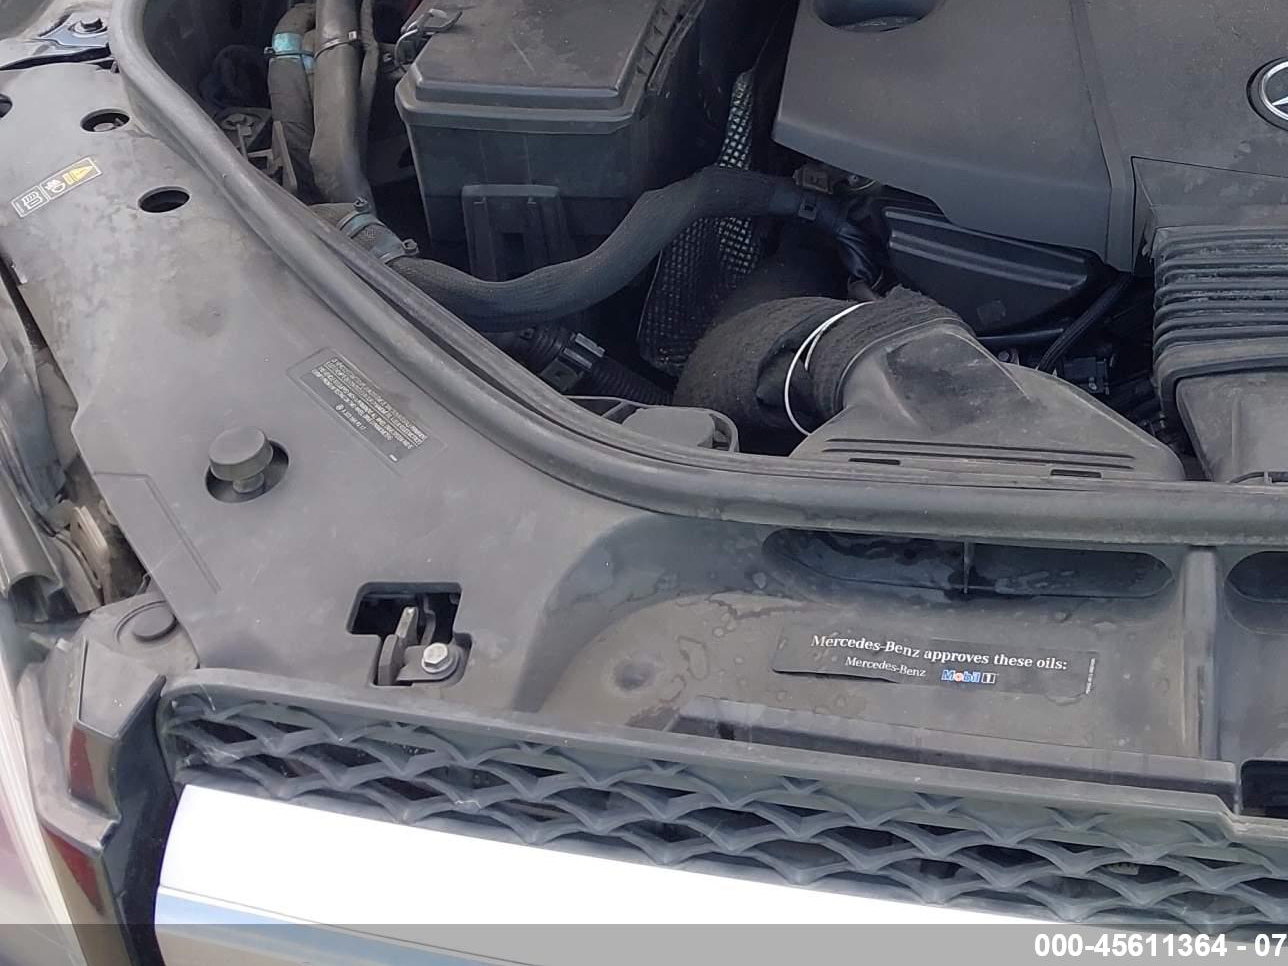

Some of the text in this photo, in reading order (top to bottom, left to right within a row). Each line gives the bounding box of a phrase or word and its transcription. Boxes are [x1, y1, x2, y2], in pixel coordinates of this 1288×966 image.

[811, 634, 1068, 670] Mercedes-Benz approves these oils:
[844, 656, 926, 677] Mercedes-Benz
[941, 669, 981, 683] Mobil
